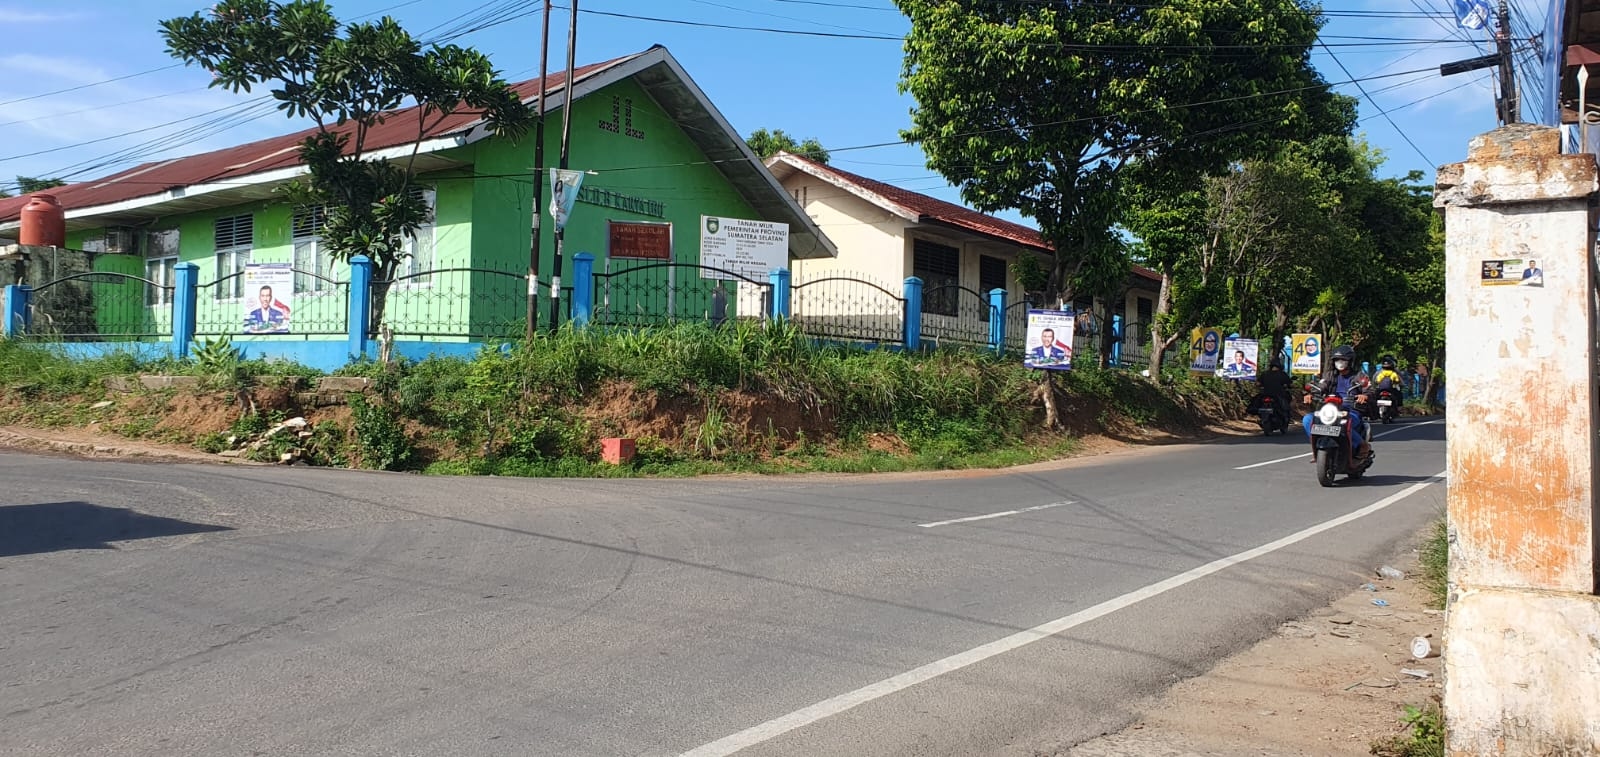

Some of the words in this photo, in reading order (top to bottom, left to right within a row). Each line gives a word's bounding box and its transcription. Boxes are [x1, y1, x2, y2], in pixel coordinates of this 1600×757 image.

[738, 220, 758, 228] TANAH
[724, 226, 759, 234] PEMERINTAH
[728, 232, 758, 241] SUMATERA
[760, 234, 783, 242] SELATAN
[1192, 337, 1203, 354] 4
[1294, 342, 1304, 356] 4
